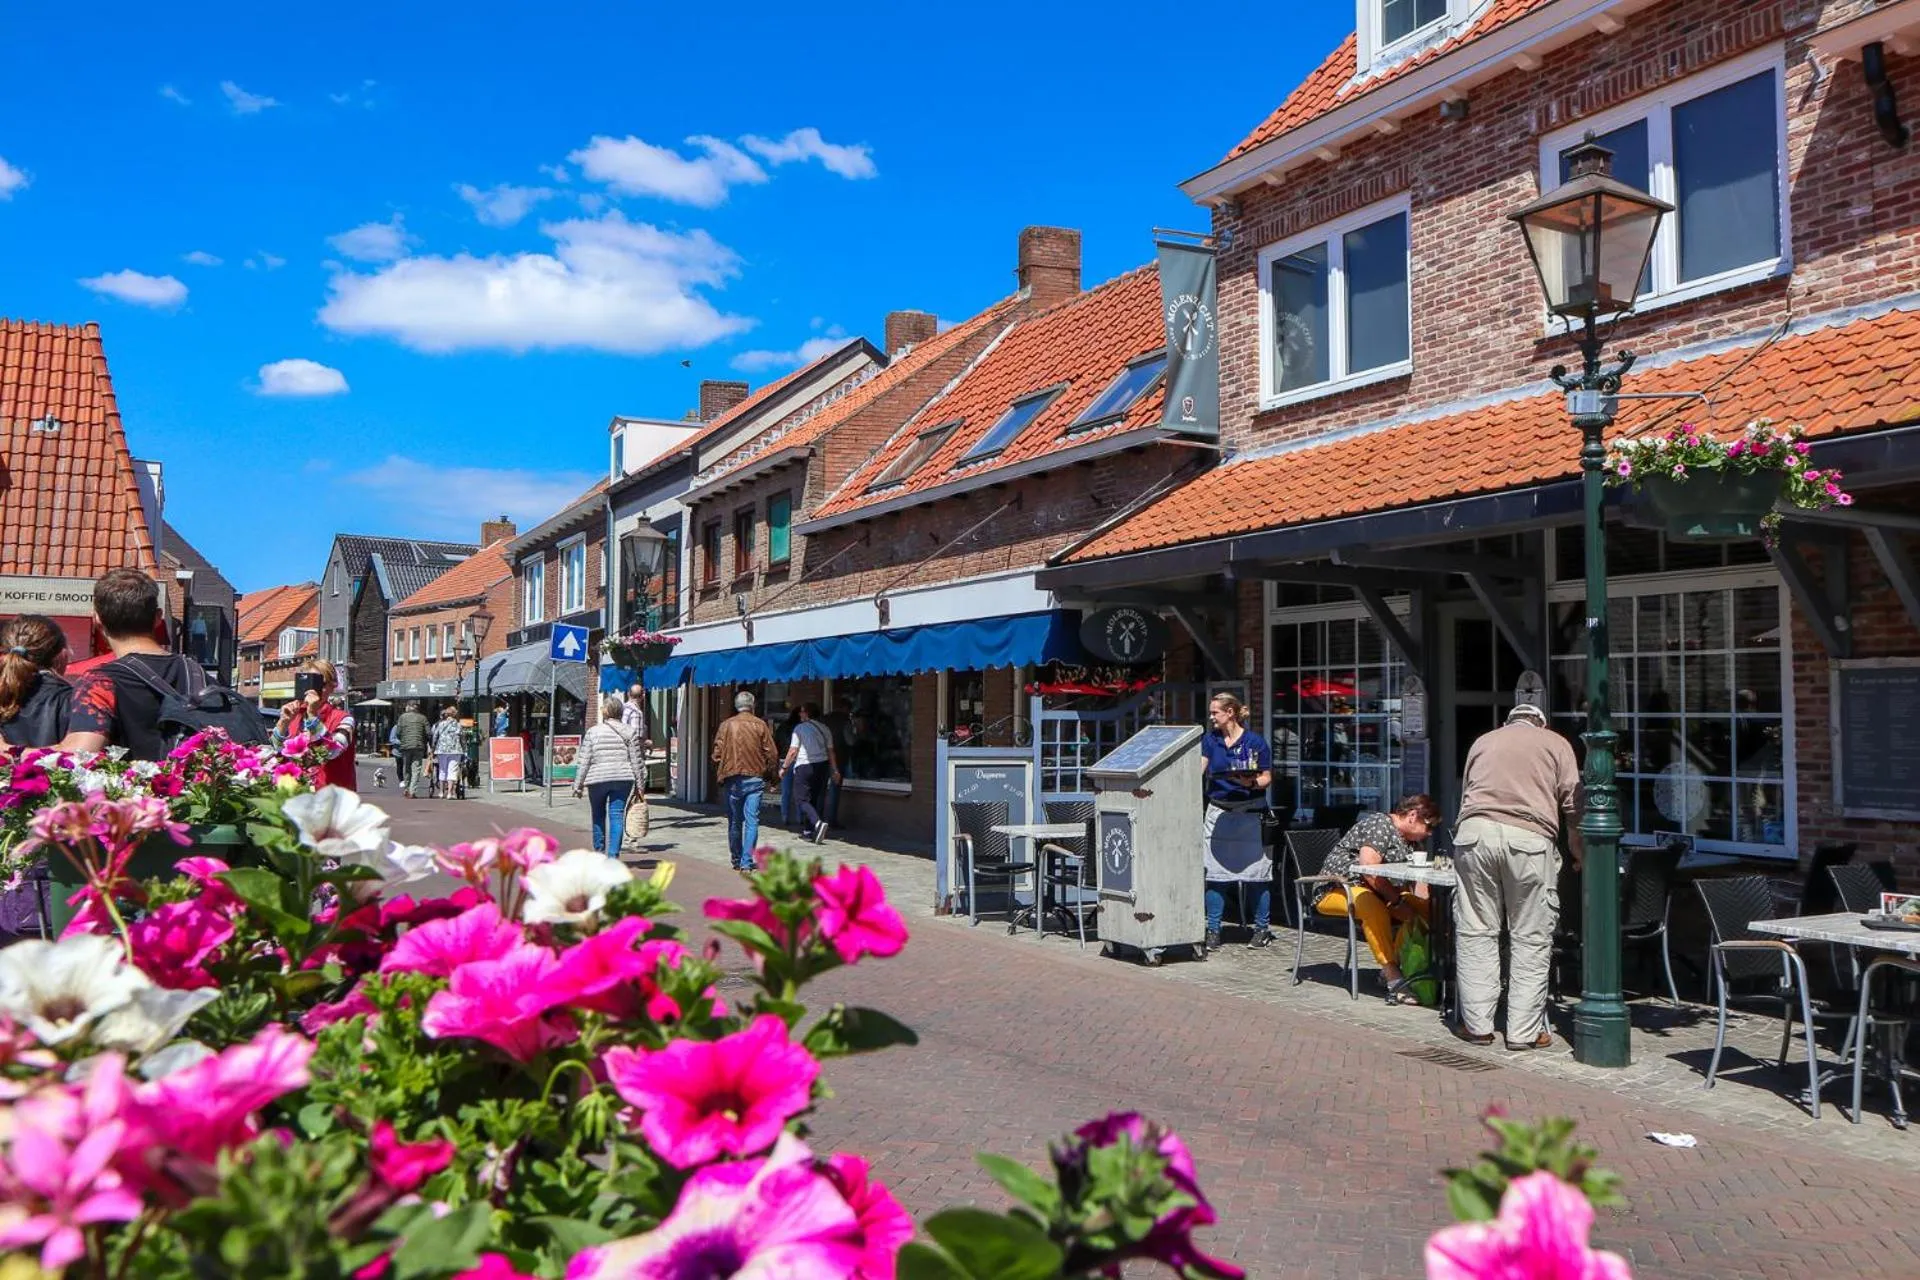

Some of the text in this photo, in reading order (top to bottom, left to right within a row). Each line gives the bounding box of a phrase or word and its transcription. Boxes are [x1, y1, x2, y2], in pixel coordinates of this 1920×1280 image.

[1167, 294, 1214, 331] MOLENZICHT
[4, 591, 46, 601] KOFFIE
[1106, 608, 1148, 637] MOLENZICHT
